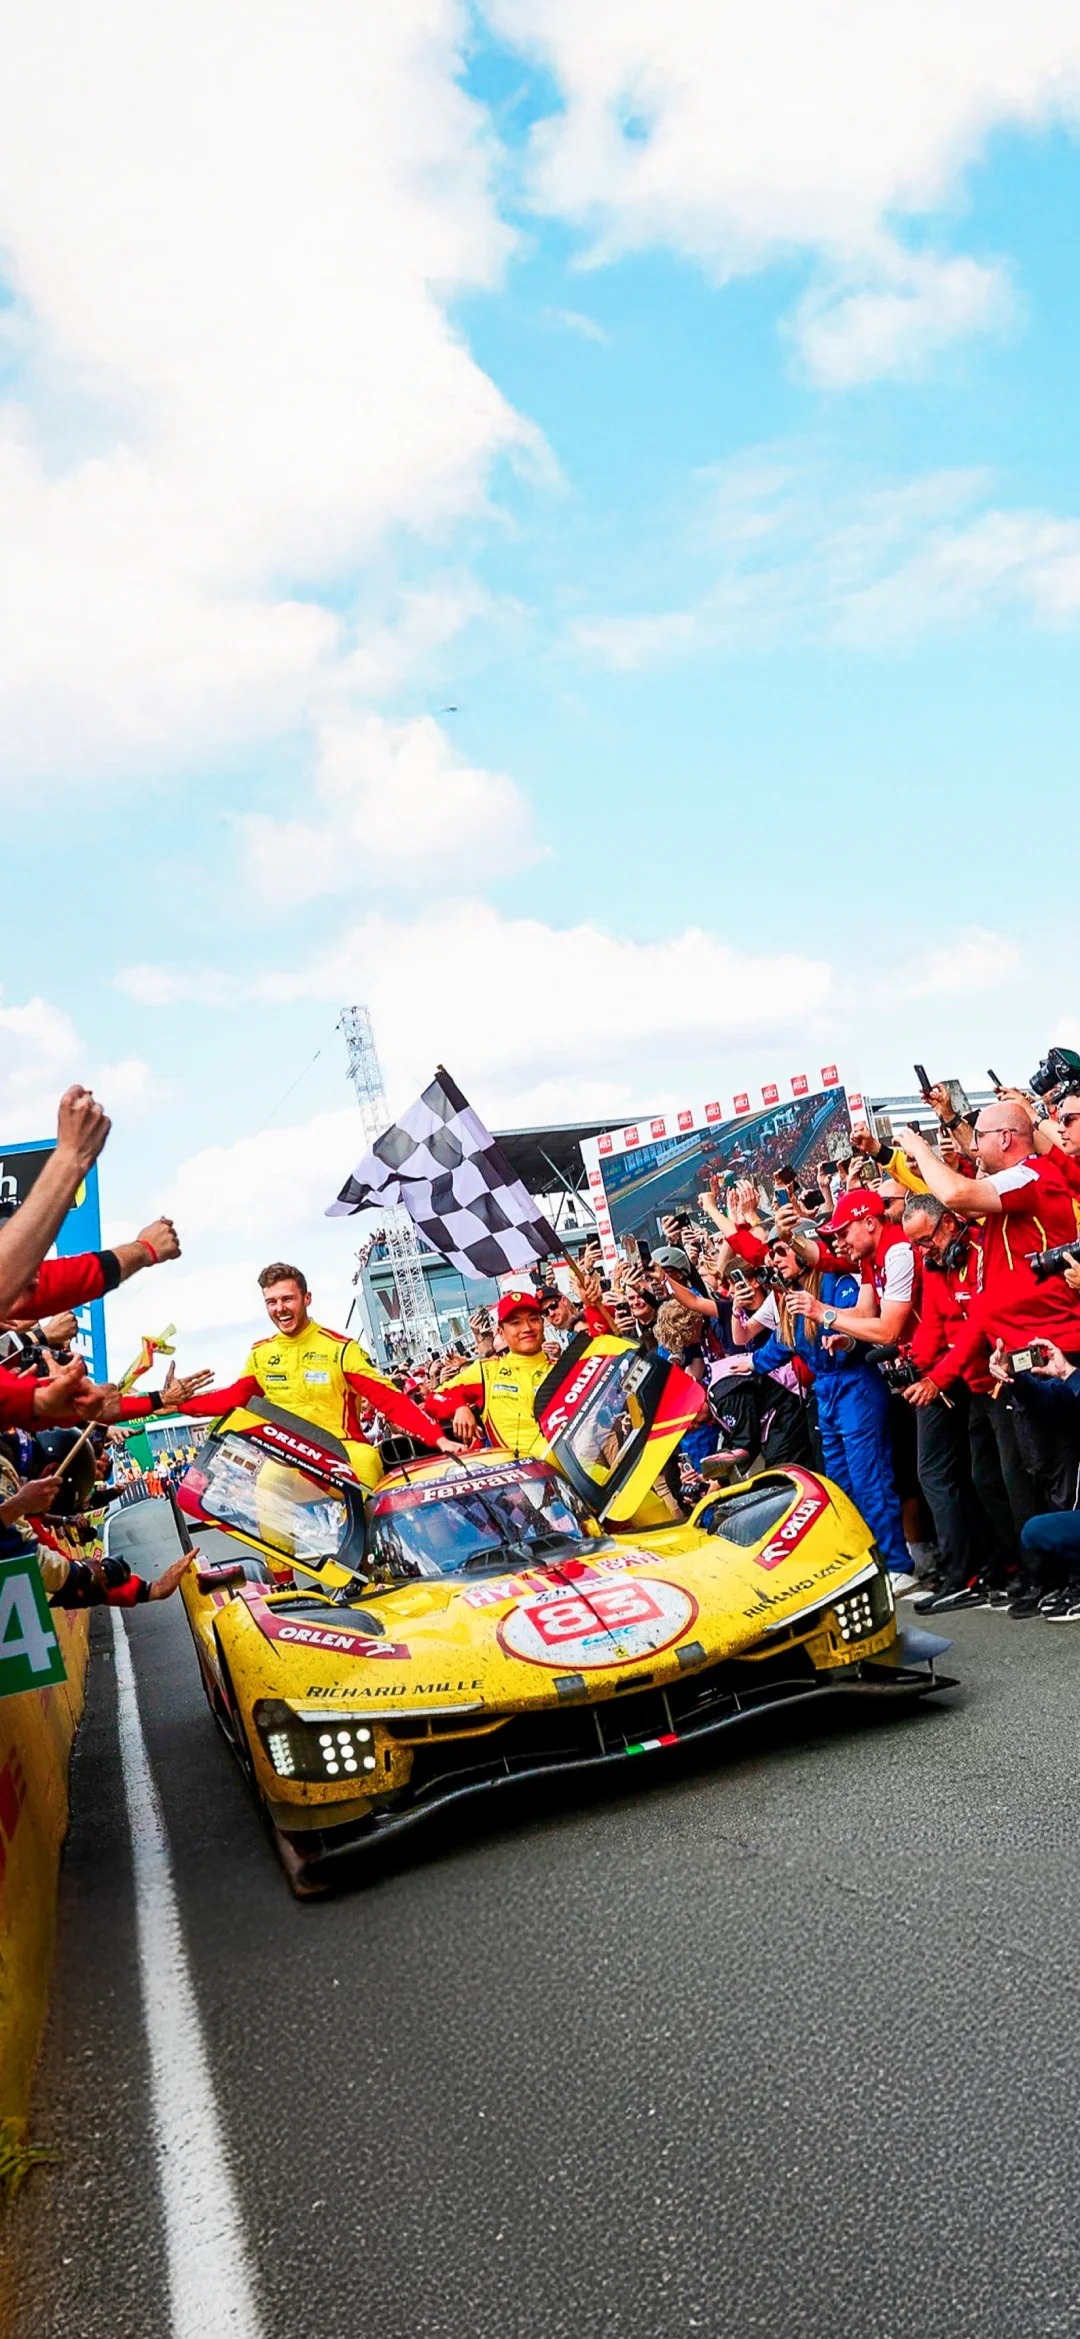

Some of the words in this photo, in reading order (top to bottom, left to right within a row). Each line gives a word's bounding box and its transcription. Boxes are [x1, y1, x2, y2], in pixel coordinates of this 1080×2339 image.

[564, 1355, 603, 1404] ORLEN
[263, 1425, 323, 1461] ORLEN
[391, 1471, 467, 1495] CHARLES
[471, 1462, 516, 1478] POZZI
[421, 1469, 532, 1503] Ferrari
[537, 1588, 651, 1636] 83
[278, 1626, 355, 1650] ORLEN
[306, 1685, 407, 1698] RICHARD
[412, 1679, 485, 1695] MILLE
